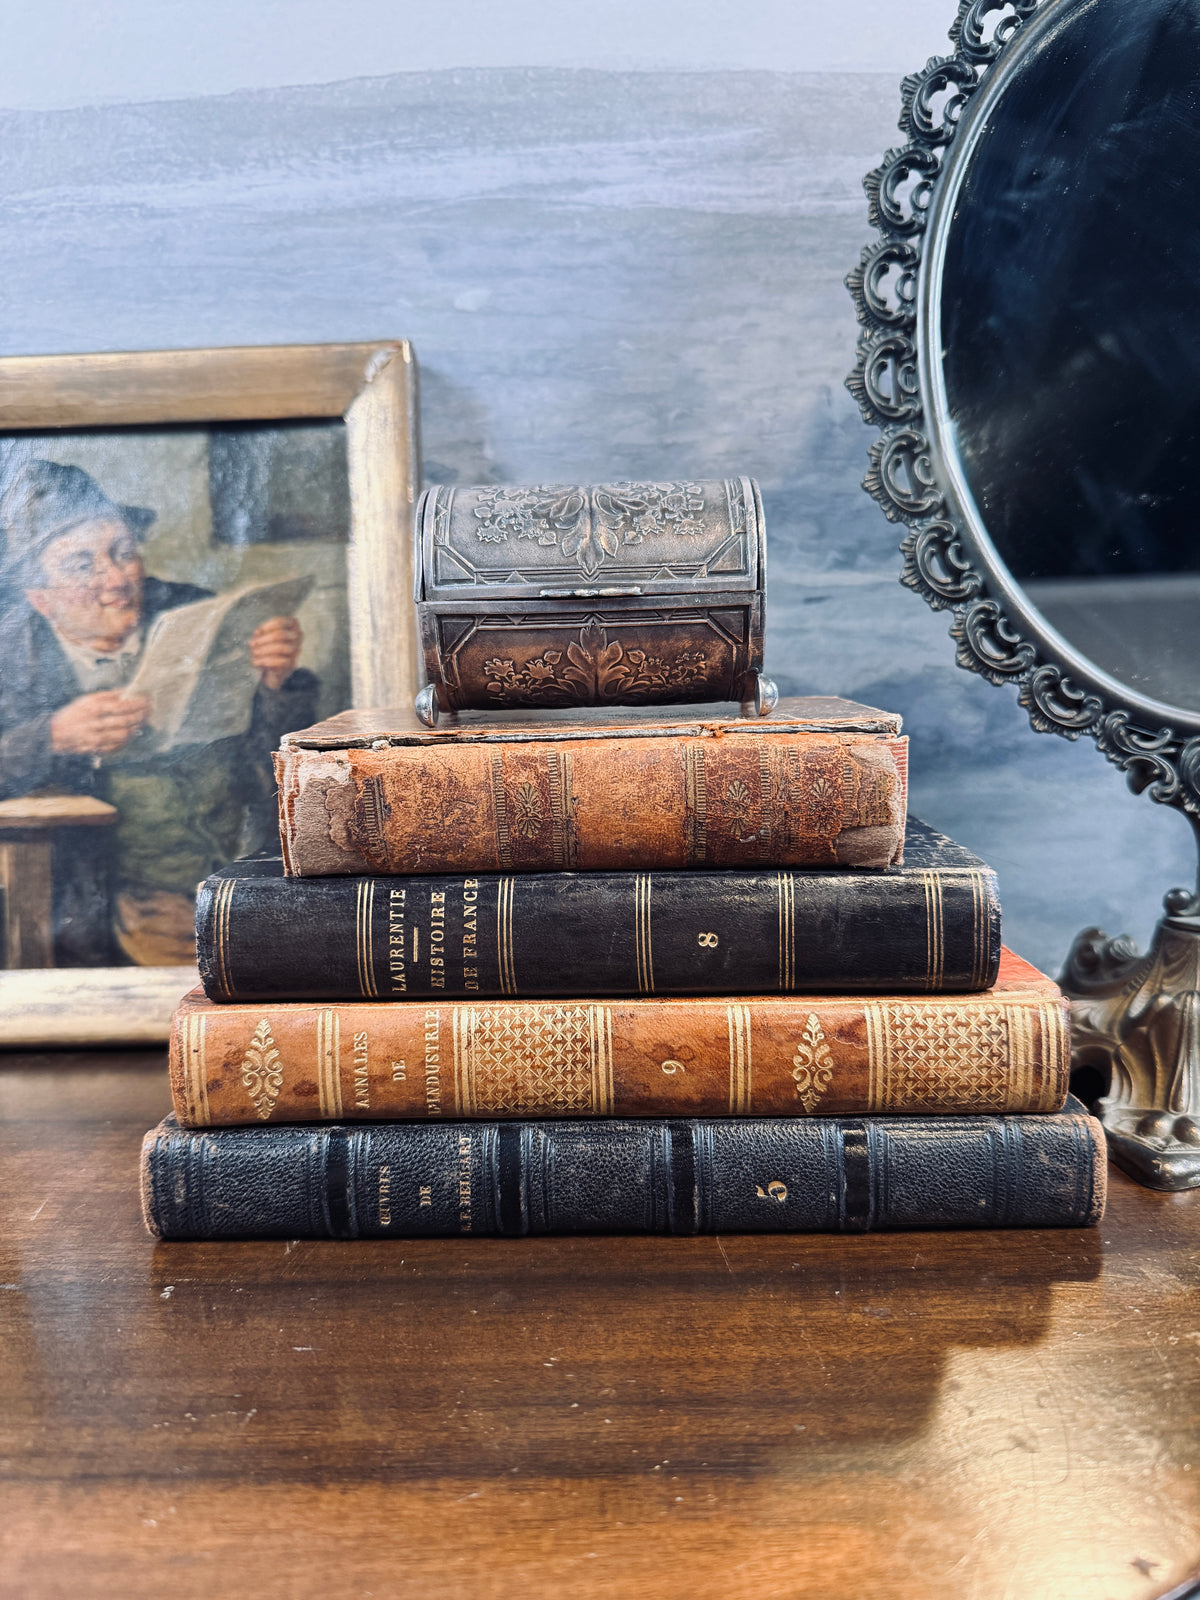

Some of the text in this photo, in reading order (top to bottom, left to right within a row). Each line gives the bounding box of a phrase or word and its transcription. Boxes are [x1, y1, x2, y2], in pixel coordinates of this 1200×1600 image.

[390, 889, 407, 992] LAURENTIE
[430, 892, 446, 989] HISTOIRE
[463, 878, 479, 991] DE FRANCE
[698, 932, 719, 948] 8
[354, 1031, 370, 1110] ANNALES
[392, 1060, 406, 1081] DE
[419, 1185, 431, 1206] DE
[756, 1181, 787, 1201] 5
